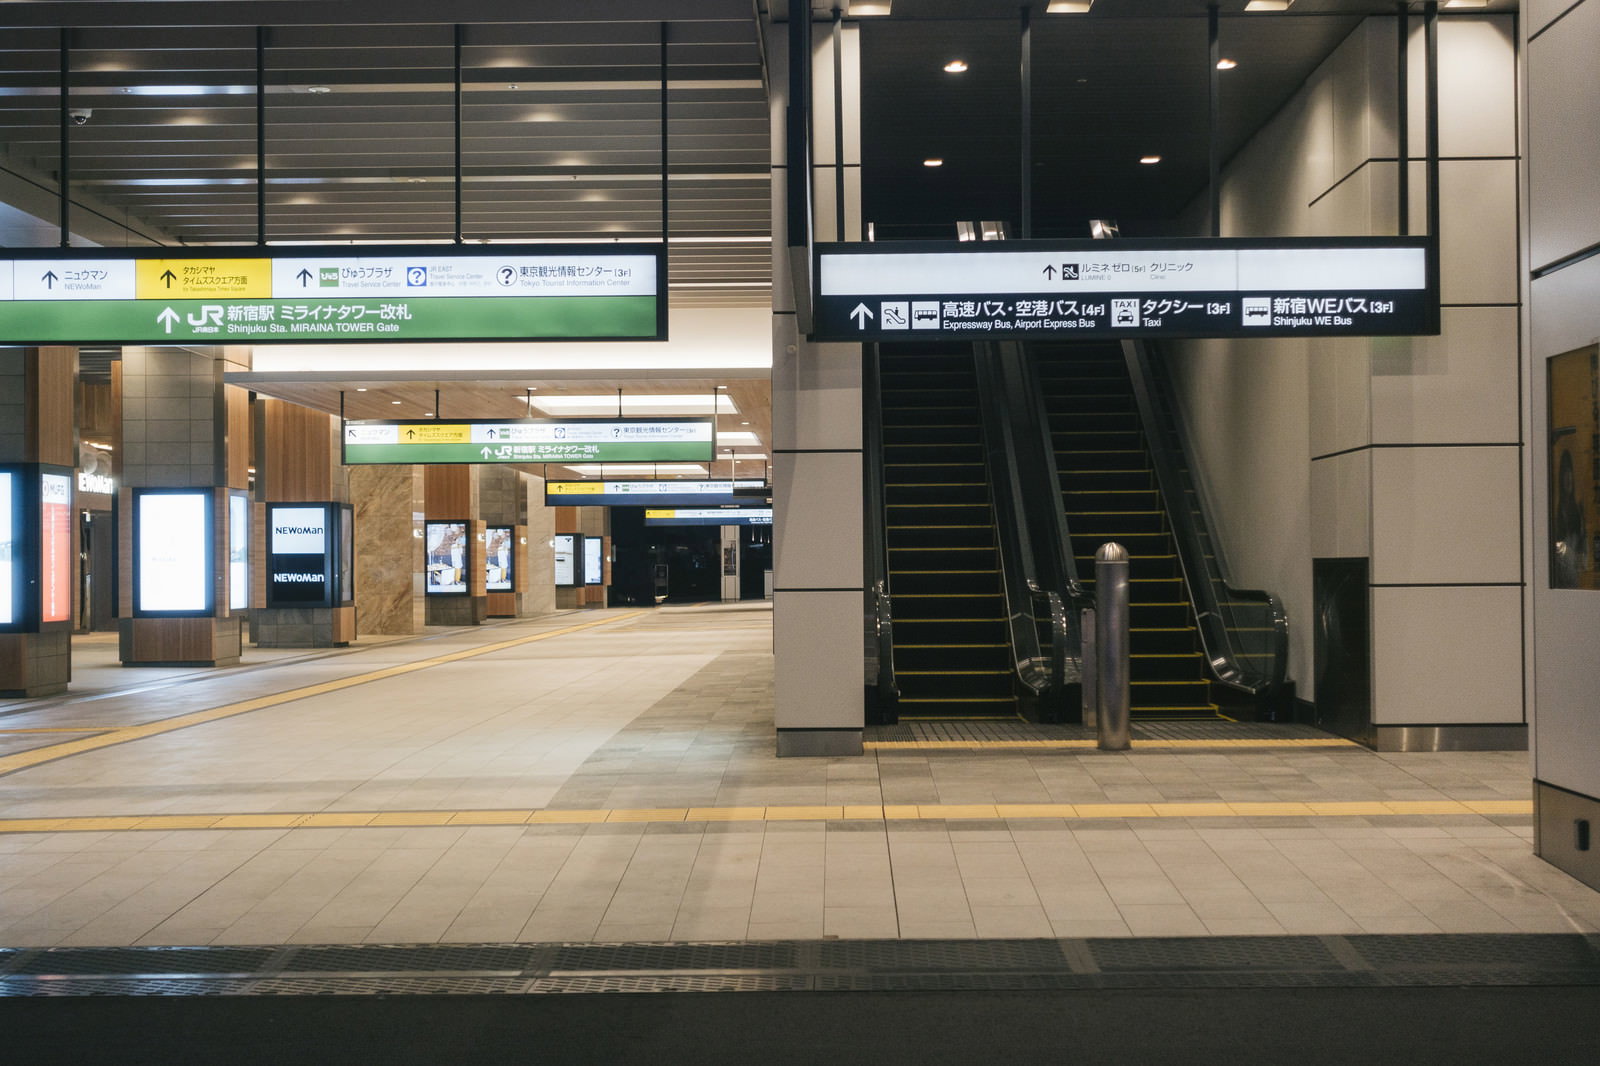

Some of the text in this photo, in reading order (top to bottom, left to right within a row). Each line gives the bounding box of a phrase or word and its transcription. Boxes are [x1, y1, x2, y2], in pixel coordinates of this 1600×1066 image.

[183, 266, 216, 275] タカシマヤ
[341, 267, 393, 279] びゅうプラザ
[520, 265, 613, 278] 東京観光情報センター
[1081, 264, 1110, 273] ルミネ
[1112, 263, 1130, 273] ゼロ
[1150, 263, 1194, 273] クリニック
[64, 270, 108, 281] ニュウマン
[183, 276, 248, 286] タイムズスクエア方面
[520, 278, 631, 288] Tokyo Tourist Information Center
[942, 300, 1080, 318] 高速バス・空港バス
[1113, 301, 1137, 309] TAXI
[1142, 299, 1204, 314] タクシー
[1273, 298, 1368, 314] 新宿WEバス
[187, 304, 225, 327] JR
[227, 303, 412, 322] 新宿駅 ミライナタワー改札
[943, 318, 1096, 331] Expressway Bus, Airport Express Bus
[1142, 318, 1162, 327] Taxi
[1273, 315, 1352, 327] Shinjuku WE Bus
[227, 322, 400, 335] Shinjuku Sta. MIRAINA TOWER Gate
[494, 445, 513, 456] JR
[537, 444, 600, 454] ミライナタワー改札
[78, 473, 114, 494] EWoMan
[275, 526, 324, 535] NEWoMan
[273, 573, 325, 583] NEWoMan
